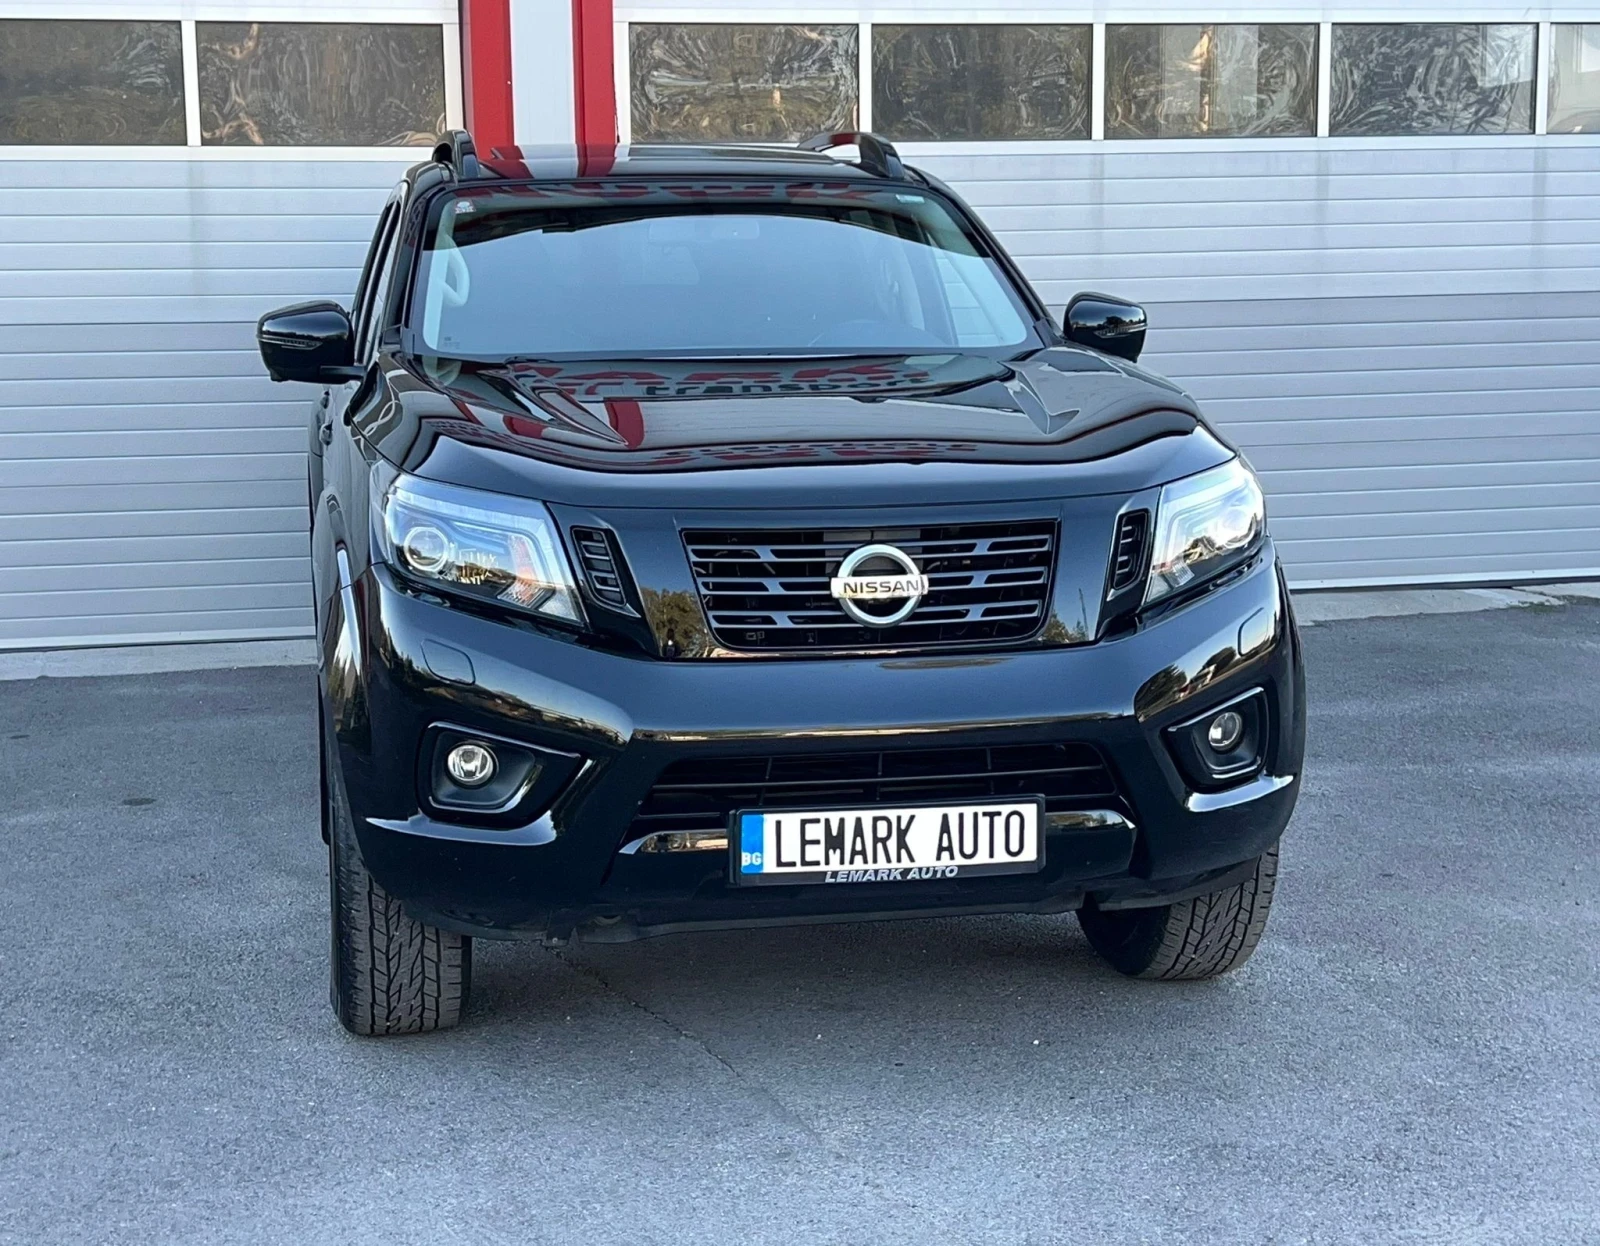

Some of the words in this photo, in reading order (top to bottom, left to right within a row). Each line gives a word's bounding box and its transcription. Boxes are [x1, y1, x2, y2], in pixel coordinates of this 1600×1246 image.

[843, 580, 919, 594] NISSAN
[775, 814, 916, 868] LEMARK
[935, 810, 1025, 862] AUTO
[741, 851, 762, 866] BG
[825, 868, 903, 883] LEMARK
[906, 865, 959, 880] AUTO
